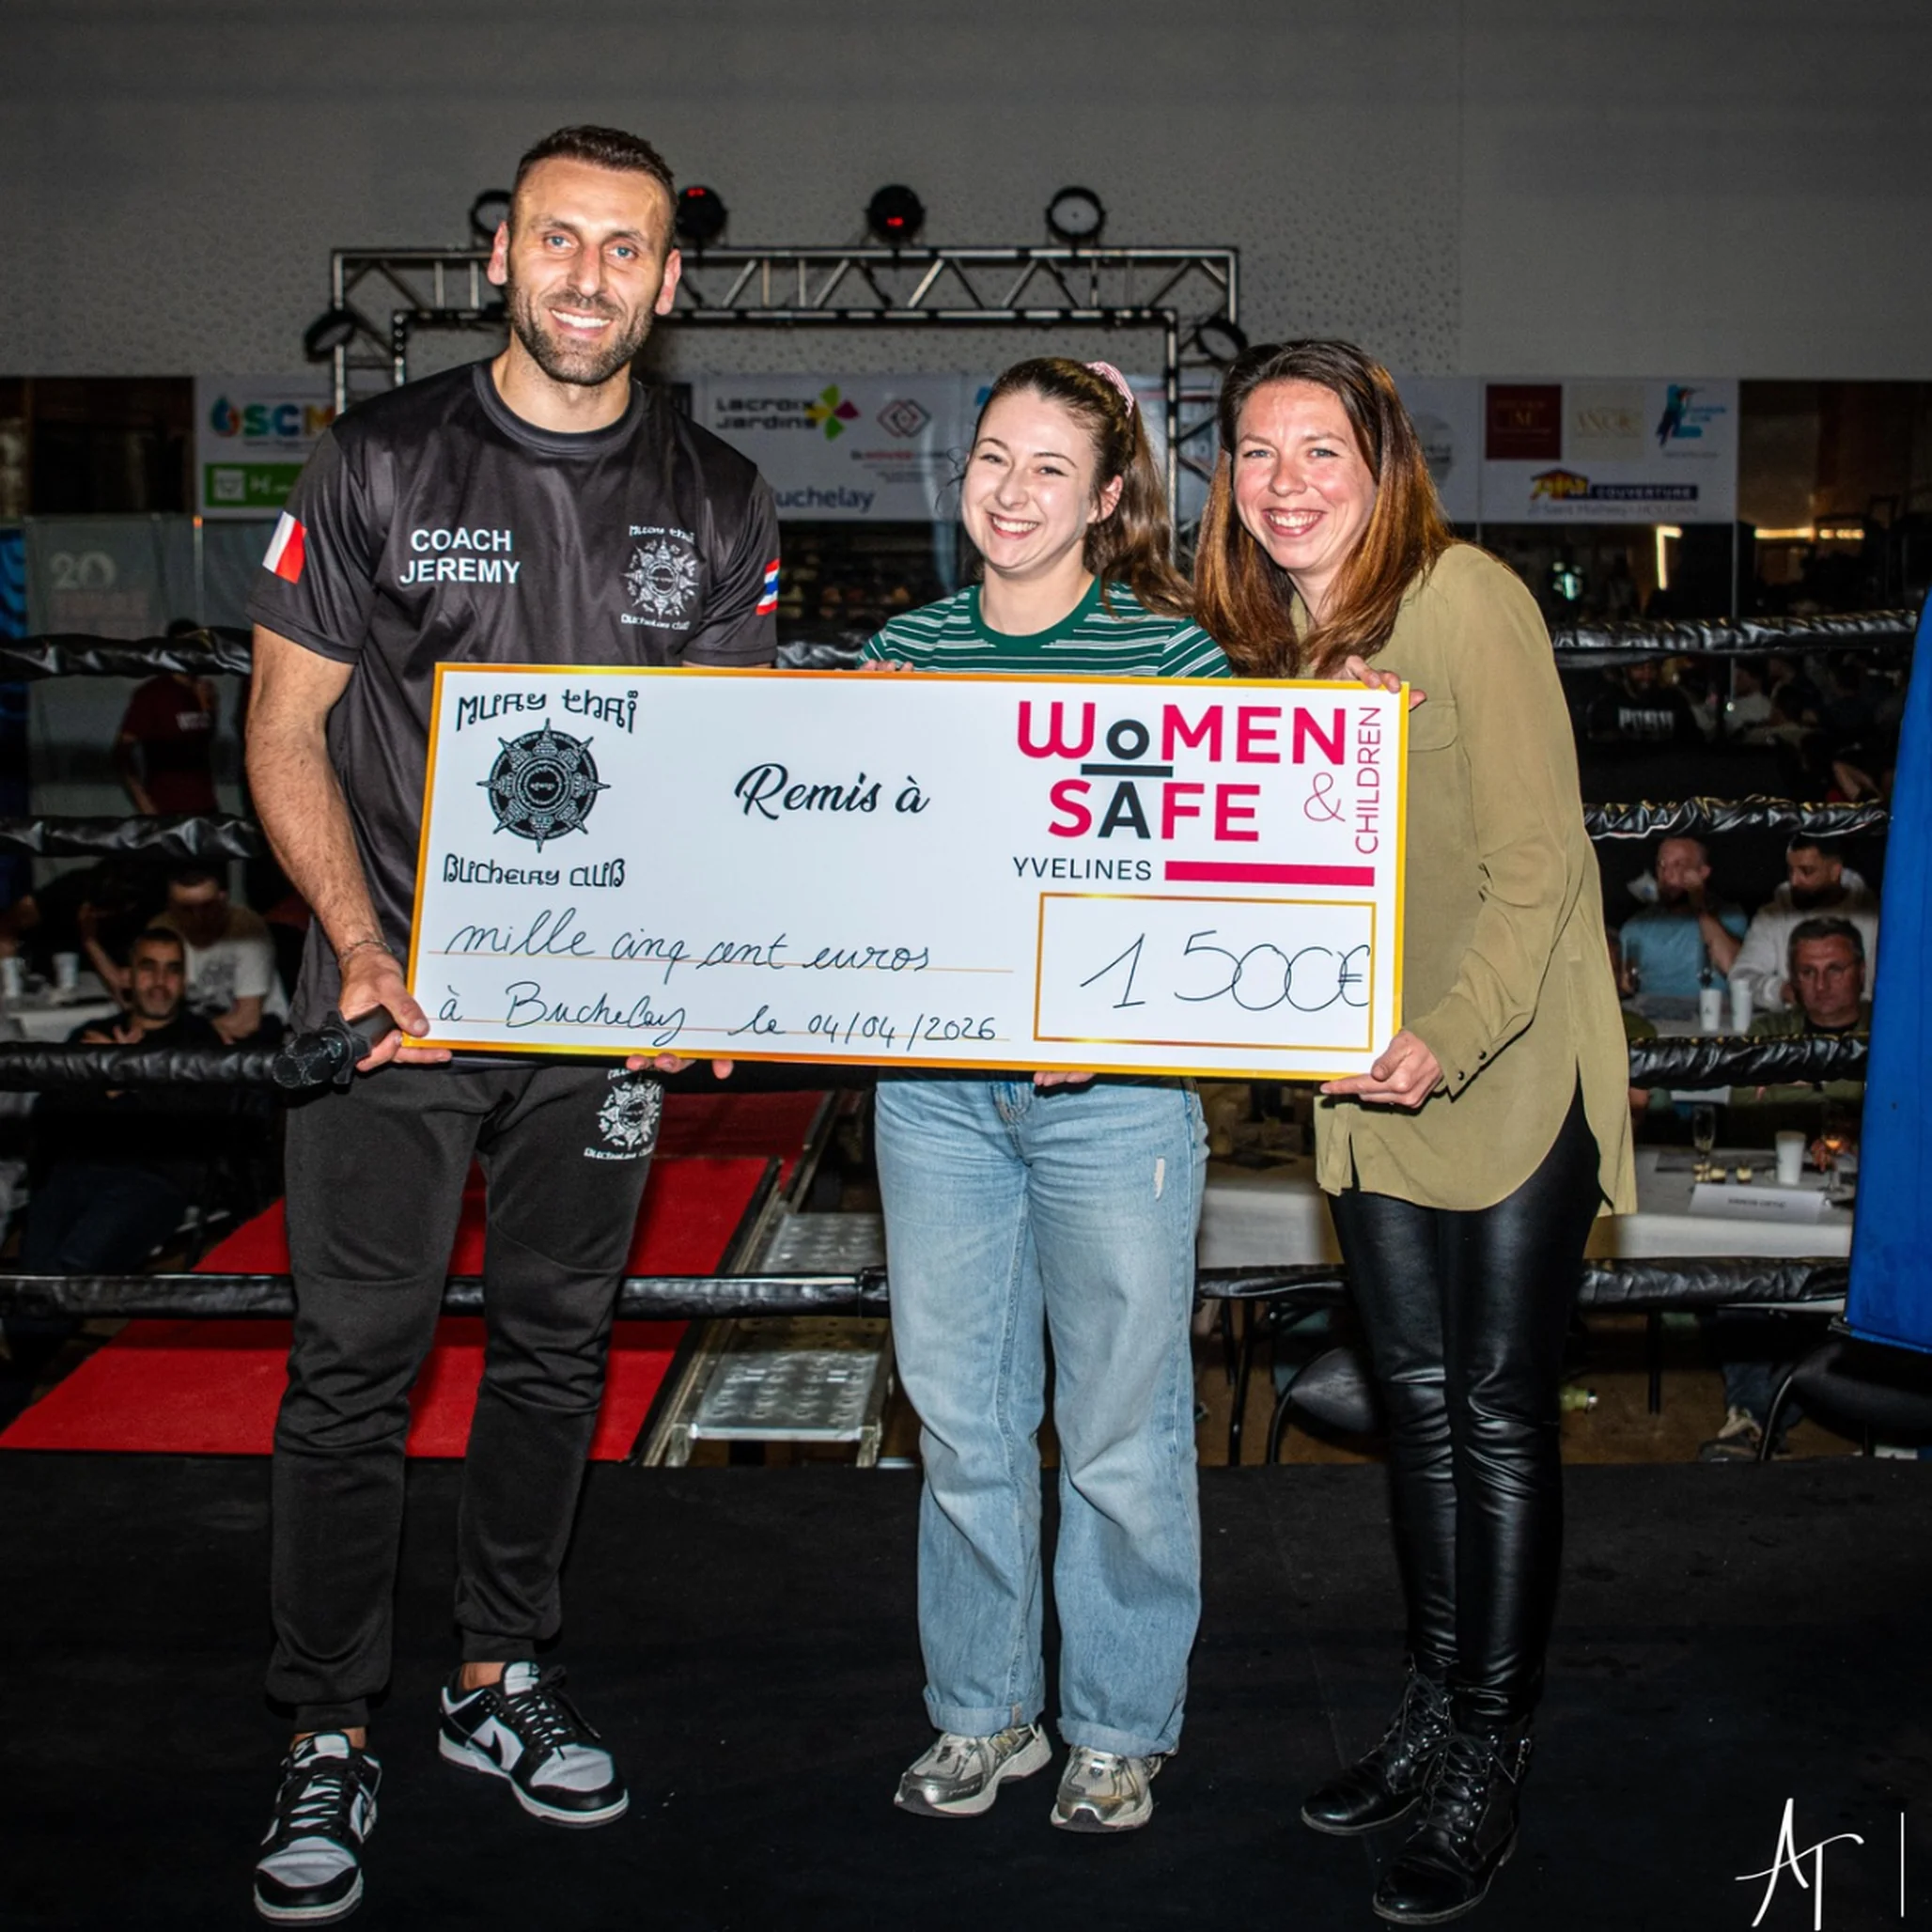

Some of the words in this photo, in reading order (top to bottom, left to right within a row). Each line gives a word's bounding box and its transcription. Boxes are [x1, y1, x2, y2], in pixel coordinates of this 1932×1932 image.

[776, 485, 875, 513] uchelay
[410, 528, 511, 552] COACH
[399, 558, 521, 584] JEREMY
[734, 762, 882, 820] Remis
[895, 774, 931, 814] à
[1048, 779, 1260, 842] SAFE
[1303, 771, 1346, 822] &
[1355, 707, 1381, 854] CHILDREN
[1012, 857, 1153, 881] YVELINES
[444, 907, 595, 956] mille
[802, 945, 930, 972] euros
[1080, 933, 1145, 1008] 1
[439, 985, 463, 1021] à
[505, 981, 686, 1048] Buchelay
[727, 1005, 787, 1036] le
[807, 1012, 996, 1052] 04/04/2026
